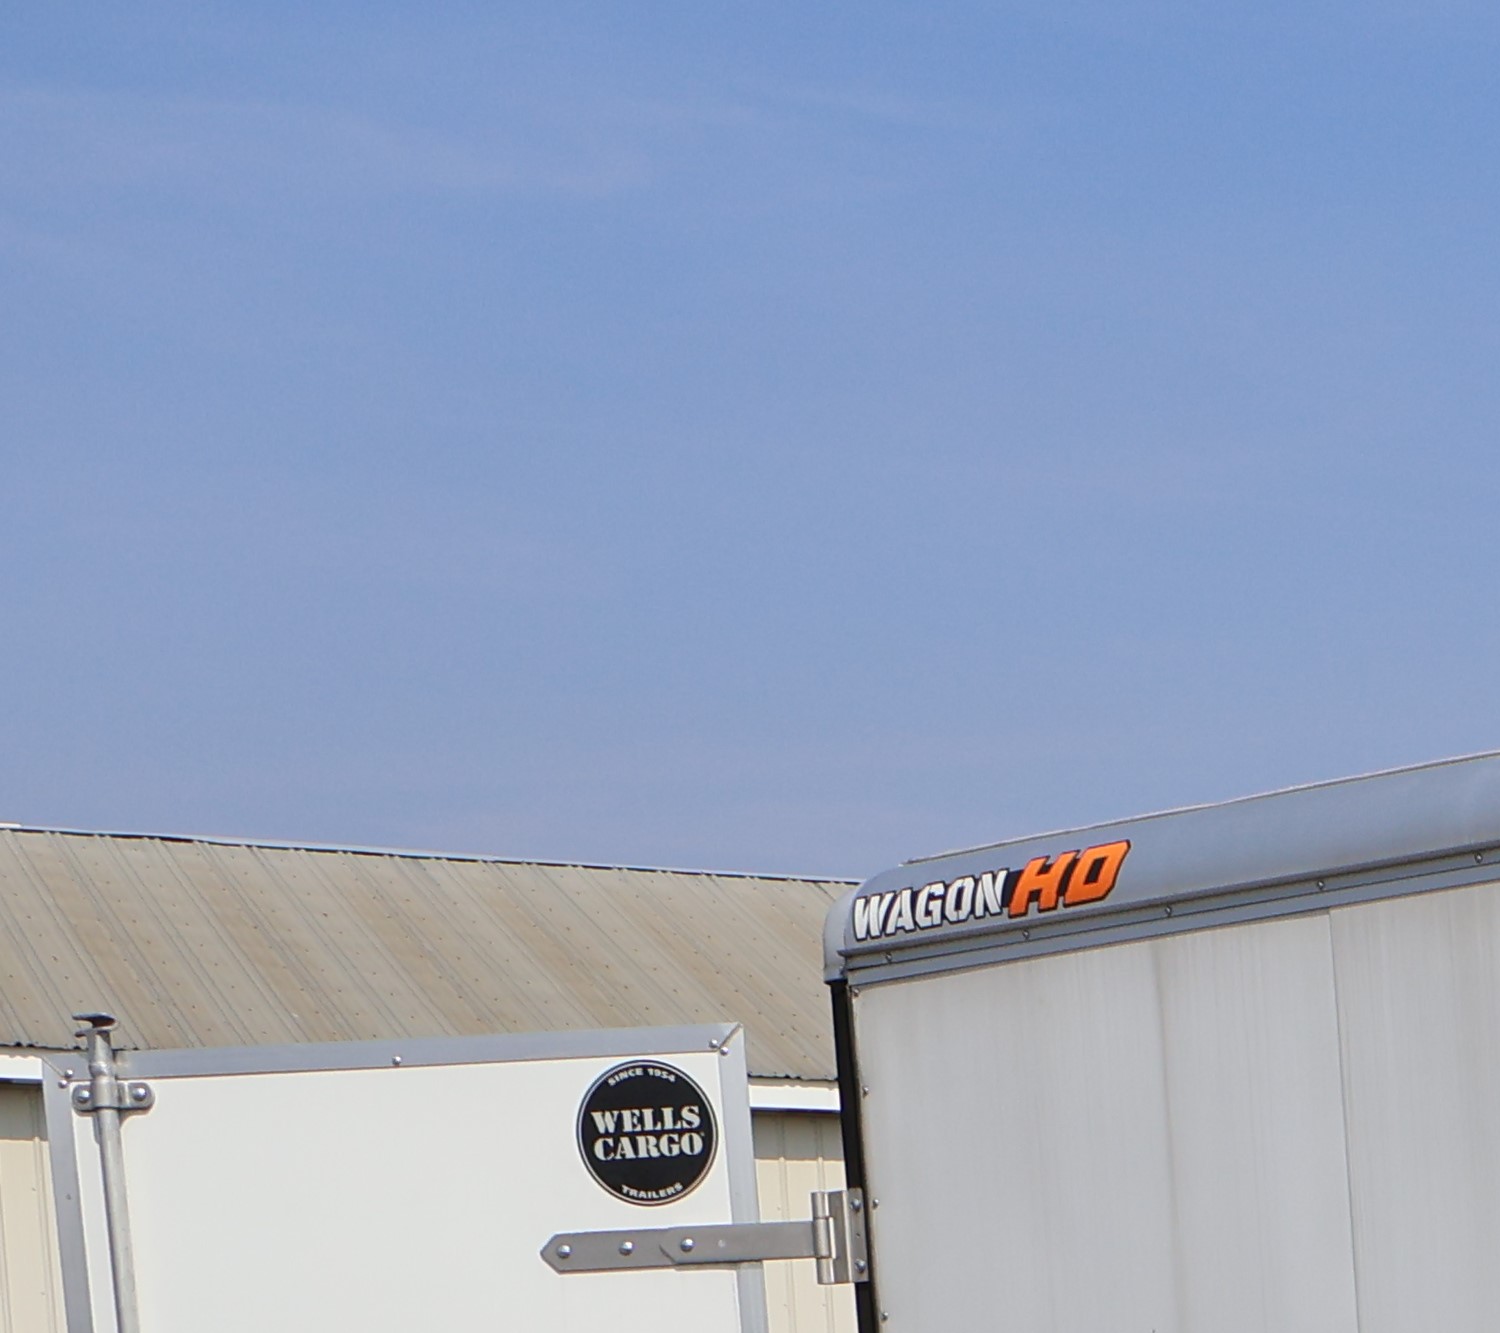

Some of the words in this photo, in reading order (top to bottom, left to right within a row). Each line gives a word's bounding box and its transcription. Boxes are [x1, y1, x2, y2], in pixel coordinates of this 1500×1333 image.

[853, 867, 1008, 941] WAGON
[607, 1067, 643, 1086] SINCE
[647, 1067, 676, 1083] 1954
[591, 1105, 701, 1134] WELLS
[594, 1132, 704, 1161] CARGO
[621, 1182, 684, 1199] TRAILERS
